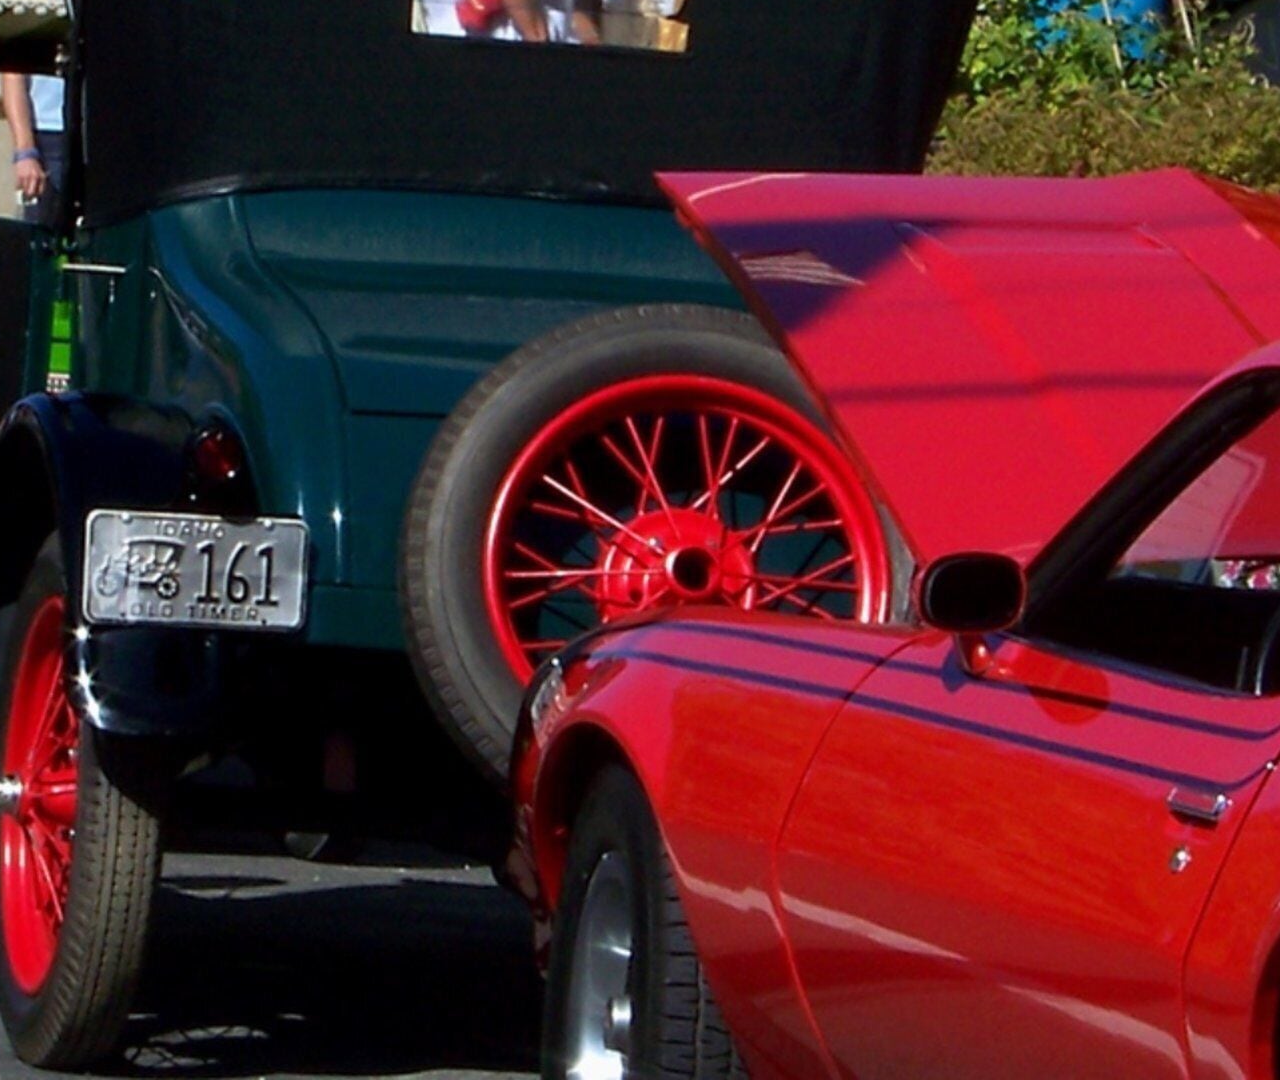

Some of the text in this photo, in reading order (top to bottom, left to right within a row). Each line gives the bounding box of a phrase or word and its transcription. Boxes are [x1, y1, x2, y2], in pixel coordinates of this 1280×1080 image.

[154, 520, 225, 539] IDAHO
[195, 539, 280, 607] 161
[130, 601, 260, 622] OLD TIMER
